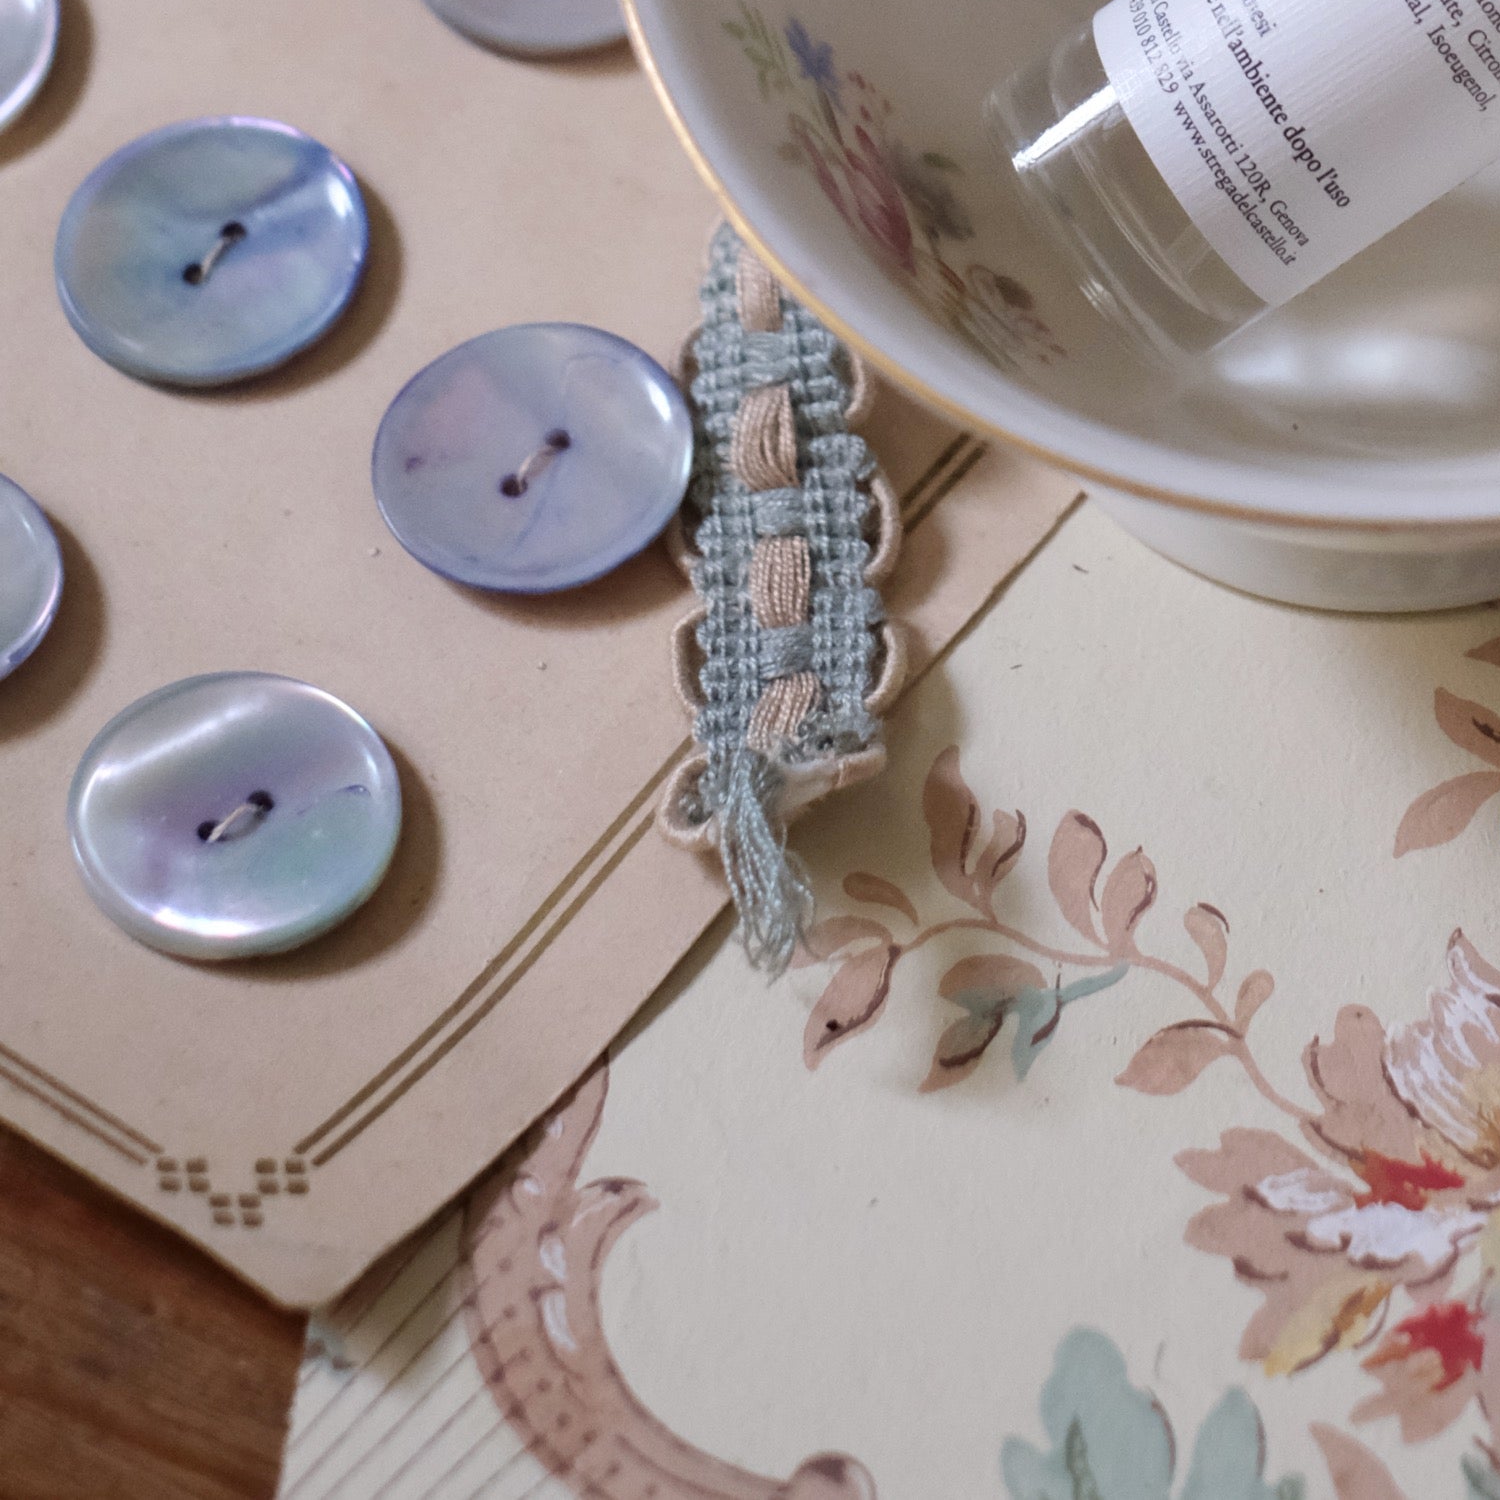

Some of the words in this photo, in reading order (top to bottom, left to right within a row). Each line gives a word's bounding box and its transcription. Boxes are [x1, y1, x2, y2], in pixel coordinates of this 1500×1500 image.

[1132, 10, 1152, 37] 010
[1139, 34, 1162, 65] 812
[1425, 23, 1497, 113] Isoeugenol,
[1154, 62, 1180, 95] 829
[1153, 0, 1183, 55] Castello
[1176, 59, 1195, 82] via
[1188, 81, 1244, 156] Assarotti
[1234, 152, 1272, 204] 120R,
[1269, 199, 1310, 248] Genova
[1282, 125, 1322, 173] dopo
[1173, 99, 1297, 266] www.stregadelcastello.it
